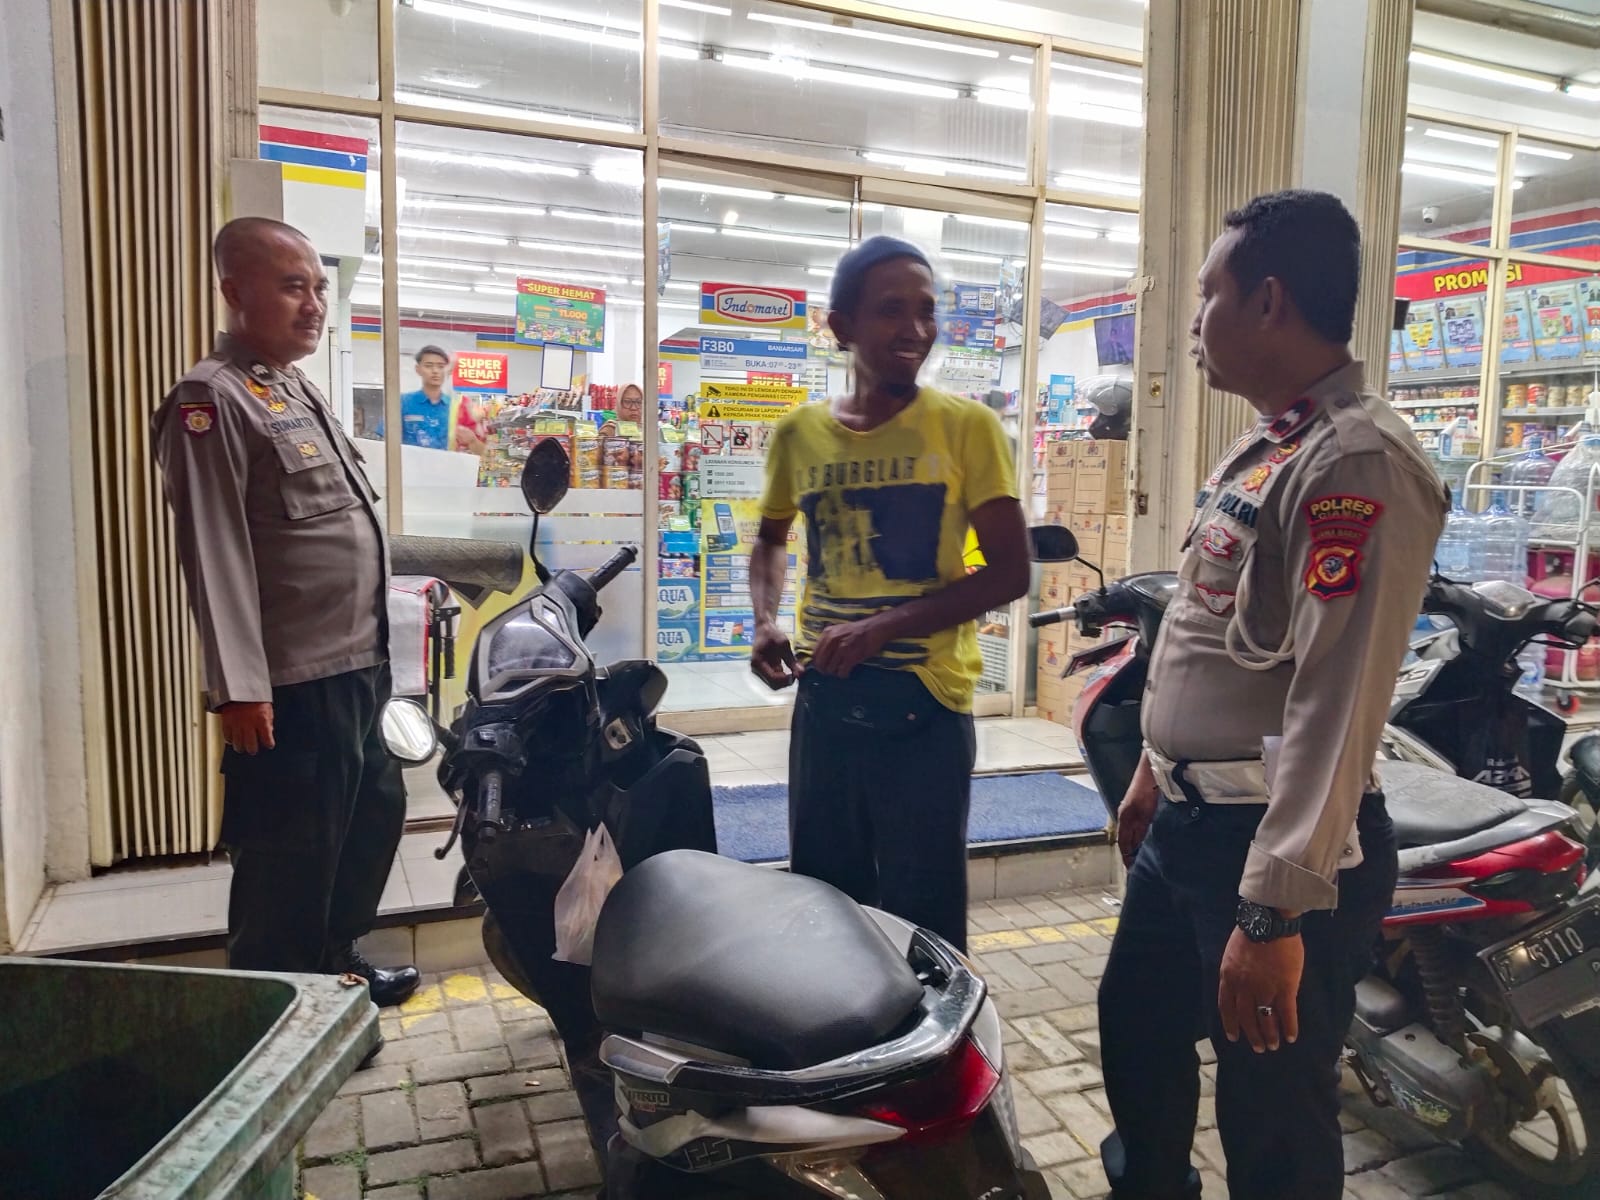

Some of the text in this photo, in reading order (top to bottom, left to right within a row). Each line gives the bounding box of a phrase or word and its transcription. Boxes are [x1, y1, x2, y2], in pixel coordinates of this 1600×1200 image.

[1433, 264, 1523, 292] PROMSI
[527, 283, 596, 300] SUPER HEMAT
[722, 297, 788, 316] Indomaret
[458, 358, 502, 370] SUPER
[458, 368, 502, 380] HEMAT
[1310, 498, 1376, 516] POLRES
[658, 588, 687, 604] QUA
[656, 630, 685, 646] QUA
